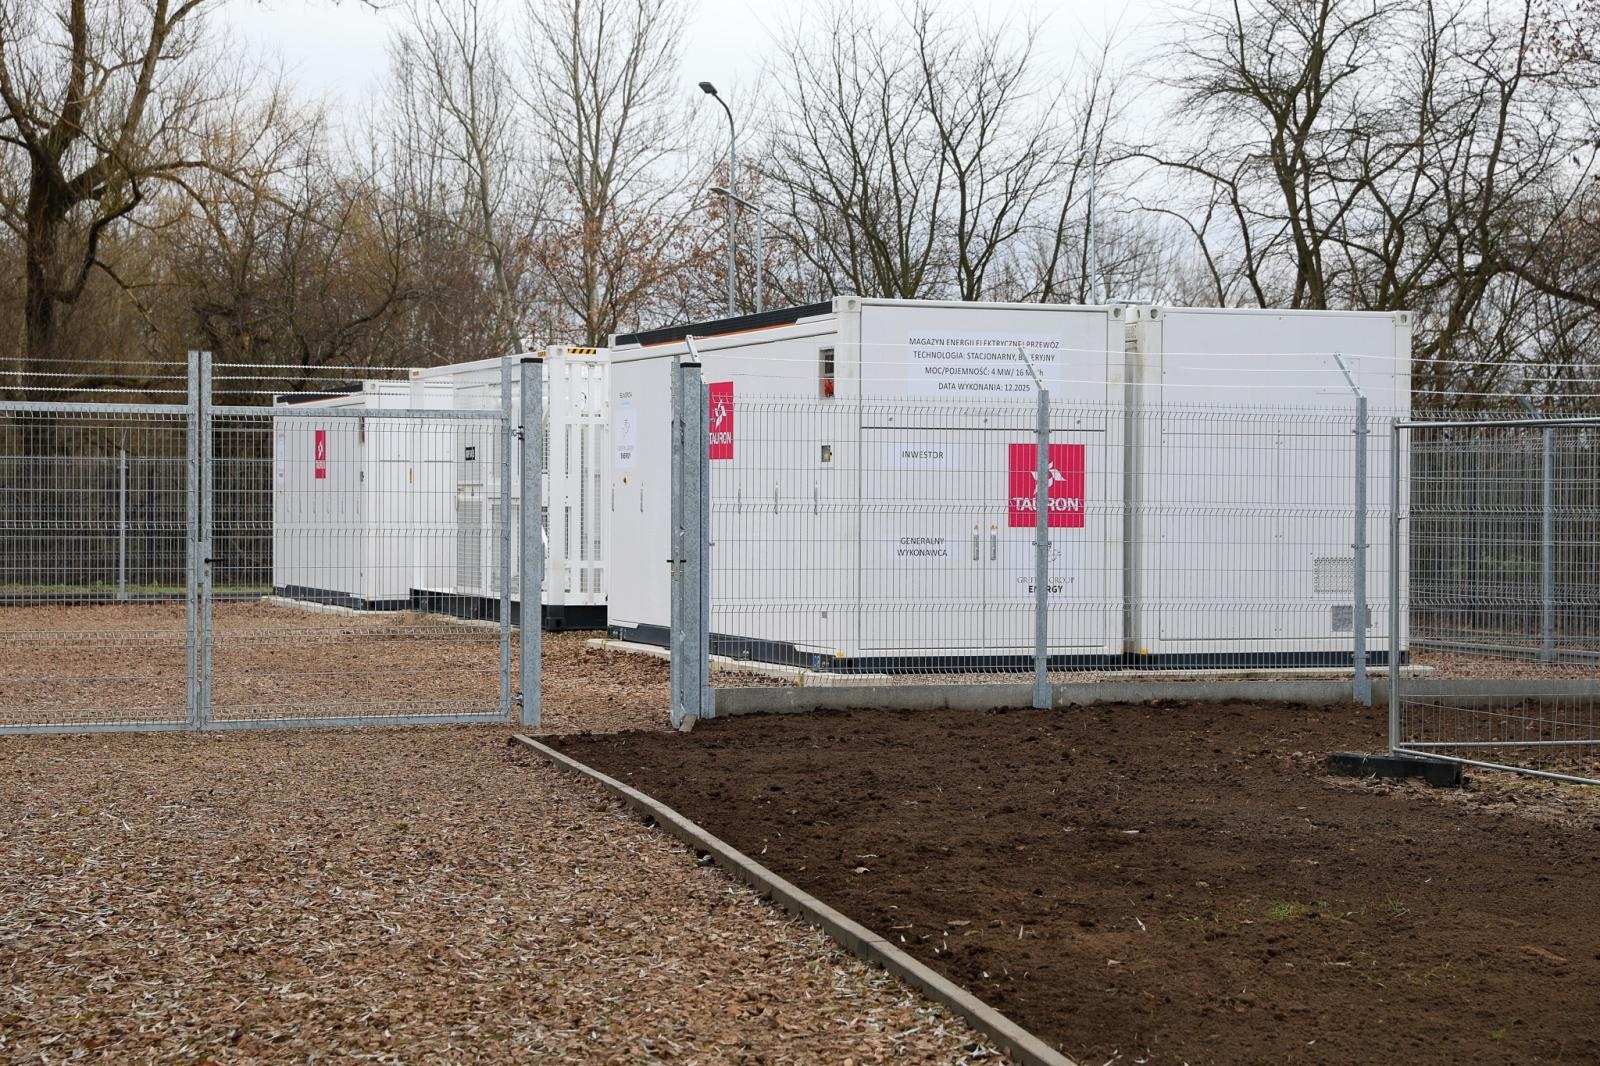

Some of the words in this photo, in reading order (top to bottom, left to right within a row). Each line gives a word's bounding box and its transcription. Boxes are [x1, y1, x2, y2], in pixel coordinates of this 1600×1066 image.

[909, 338, 945, 346] MAGAZYN
[913, 351, 966, 360] TECHNOLOGIA:
[967, 352, 1017, 361] STACJONARNY,
[1018, 353, 1055, 362] BERYJNY
[925, 366, 990, 376] MOC/POJEMNOŚĆ:
[997, 368, 1014, 376] MW/
[938, 382, 957, 390] DATA
[958, 383, 1003, 391] WYKONANIA:
[1005, 384, 1031, 392] 12.2025
[709, 432, 732, 445] TAURON
[902, 450, 944, 459] INWESTOR
[1012, 497, 1079, 511] TARON
[900, 537, 945, 545] GENERALNY
[897, 549, 947, 557] WYKONAWCA
[1049, 576, 1074, 584] GROUP
